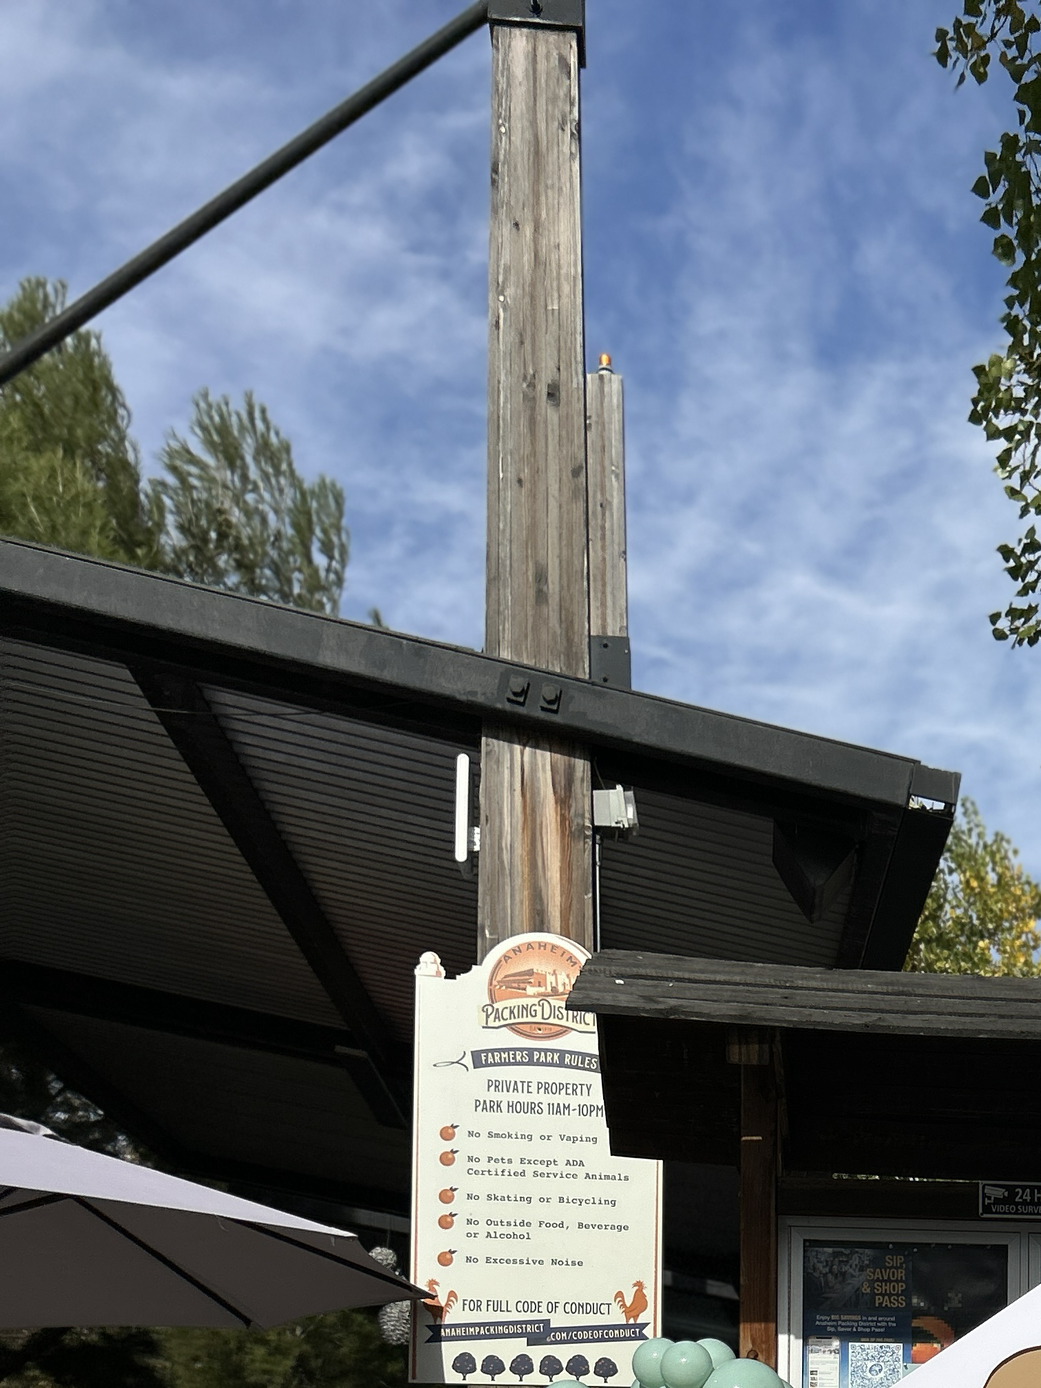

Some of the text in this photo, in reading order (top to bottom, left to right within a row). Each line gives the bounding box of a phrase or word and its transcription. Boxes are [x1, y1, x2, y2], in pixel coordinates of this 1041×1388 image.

[503, 942, 577, 968] ANAHEIM
[482, 1003, 538, 1026] PACKING
[480, 1051, 598, 1070] FARMERS PARK RULES
[487, 1079, 592, 1097] PRIVATE PROPERTY
[474, 1099, 605, 1118] PARK HOURS 11AM-10PM
[467, 1130, 481, 1139] No
[487, 1131, 533, 1142] Smoking
[559, 1134, 598, 1144] Vaping
[467, 1155, 585, 1167] No Pets Except ADA
[467, 1168, 630, 1182] Certified Service Animals
[466, 1193, 480, 1201] No
[486, 1193, 532, 1204] Skating
[558, 1196, 617, 1207] Bicycling
[1014, 1188, 1032, 1203] 24
[991, 1204, 1016, 1213] VIDEO
[466, 1218, 630, 1233] No Outside Food, Beverage
[485, 1231, 531, 1241] Alcohol
[465, 1256, 584, 1267] No Excessive Noise
[885, 1255, 906, 1269] SIP,
[866, 1268, 906, 1280] SAVOR
[862, 1282, 906, 1294] & SHOP
[461, 1298, 612, 1316] FOR FULL CODE OF CONDUCT
[875, 1296, 906, 1308] PASS
[440, 1323, 545, 1337] ANAHEIMPACKINGDISTRICT
